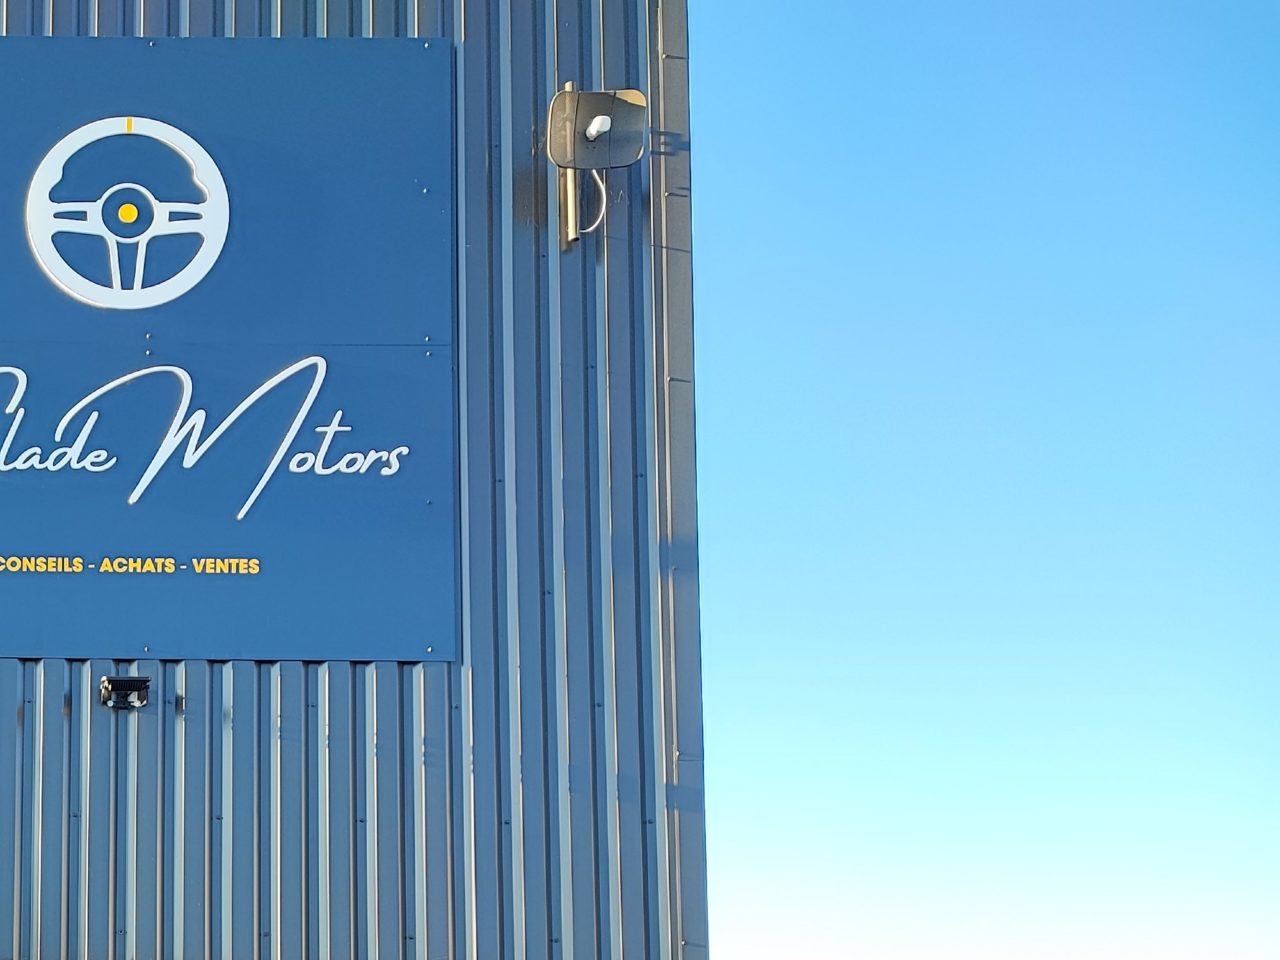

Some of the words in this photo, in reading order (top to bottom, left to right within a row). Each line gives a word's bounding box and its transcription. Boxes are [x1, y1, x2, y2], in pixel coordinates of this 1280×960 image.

[54, 355, 410, 520] Motors
[99, 557, 176, 574] ACHATS
[191, 558, 260, 575] VENTES
